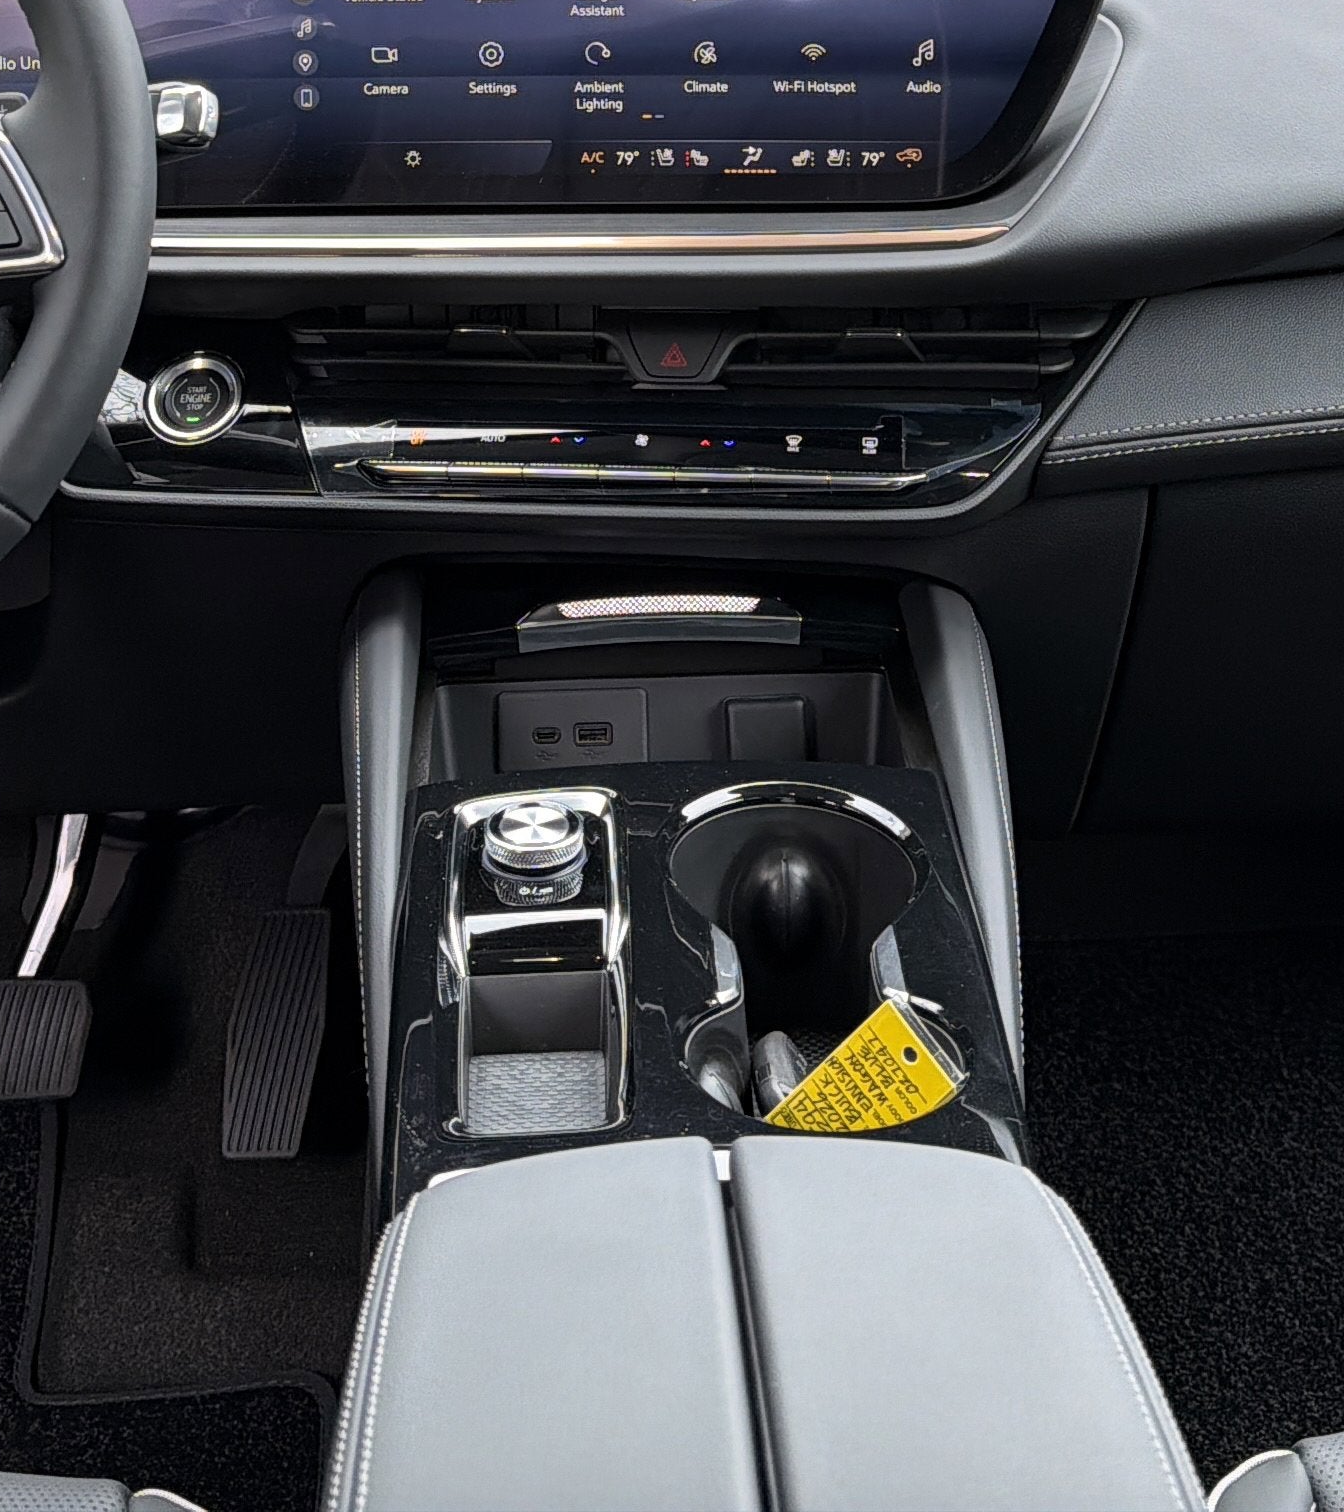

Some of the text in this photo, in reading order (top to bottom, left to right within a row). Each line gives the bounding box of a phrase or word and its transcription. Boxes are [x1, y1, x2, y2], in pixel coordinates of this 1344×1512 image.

[570, 4, 625, 17] Assistant
[363, 82, 409, 95] Camera
[468, 82, 517, 97] Settings
[574, 81, 624, 94] Ambient
[684, 80, 729, 93] Climate
[773, 80, 857, 96] Wi-Fi Hotspot
[906, 80, 941, 94] Audio
[576, 97, 623, 113] Lighting
[581, 151, 605, 164] A/C
[616, 150, 639, 165] 79°
[861, 151, 885, 166] 79°
[180, 393, 213, 404] ENGINE
[480, 434, 506, 443] AUTO
[857, 1044, 897, 1089] BLUE
[824, 1055, 874, 1114] ENVISION
[844, 1052, 889, 1107] WAGON
[817, 1073, 863, 1126] BUICK
[895, 1086, 918, 1115] COLOR
